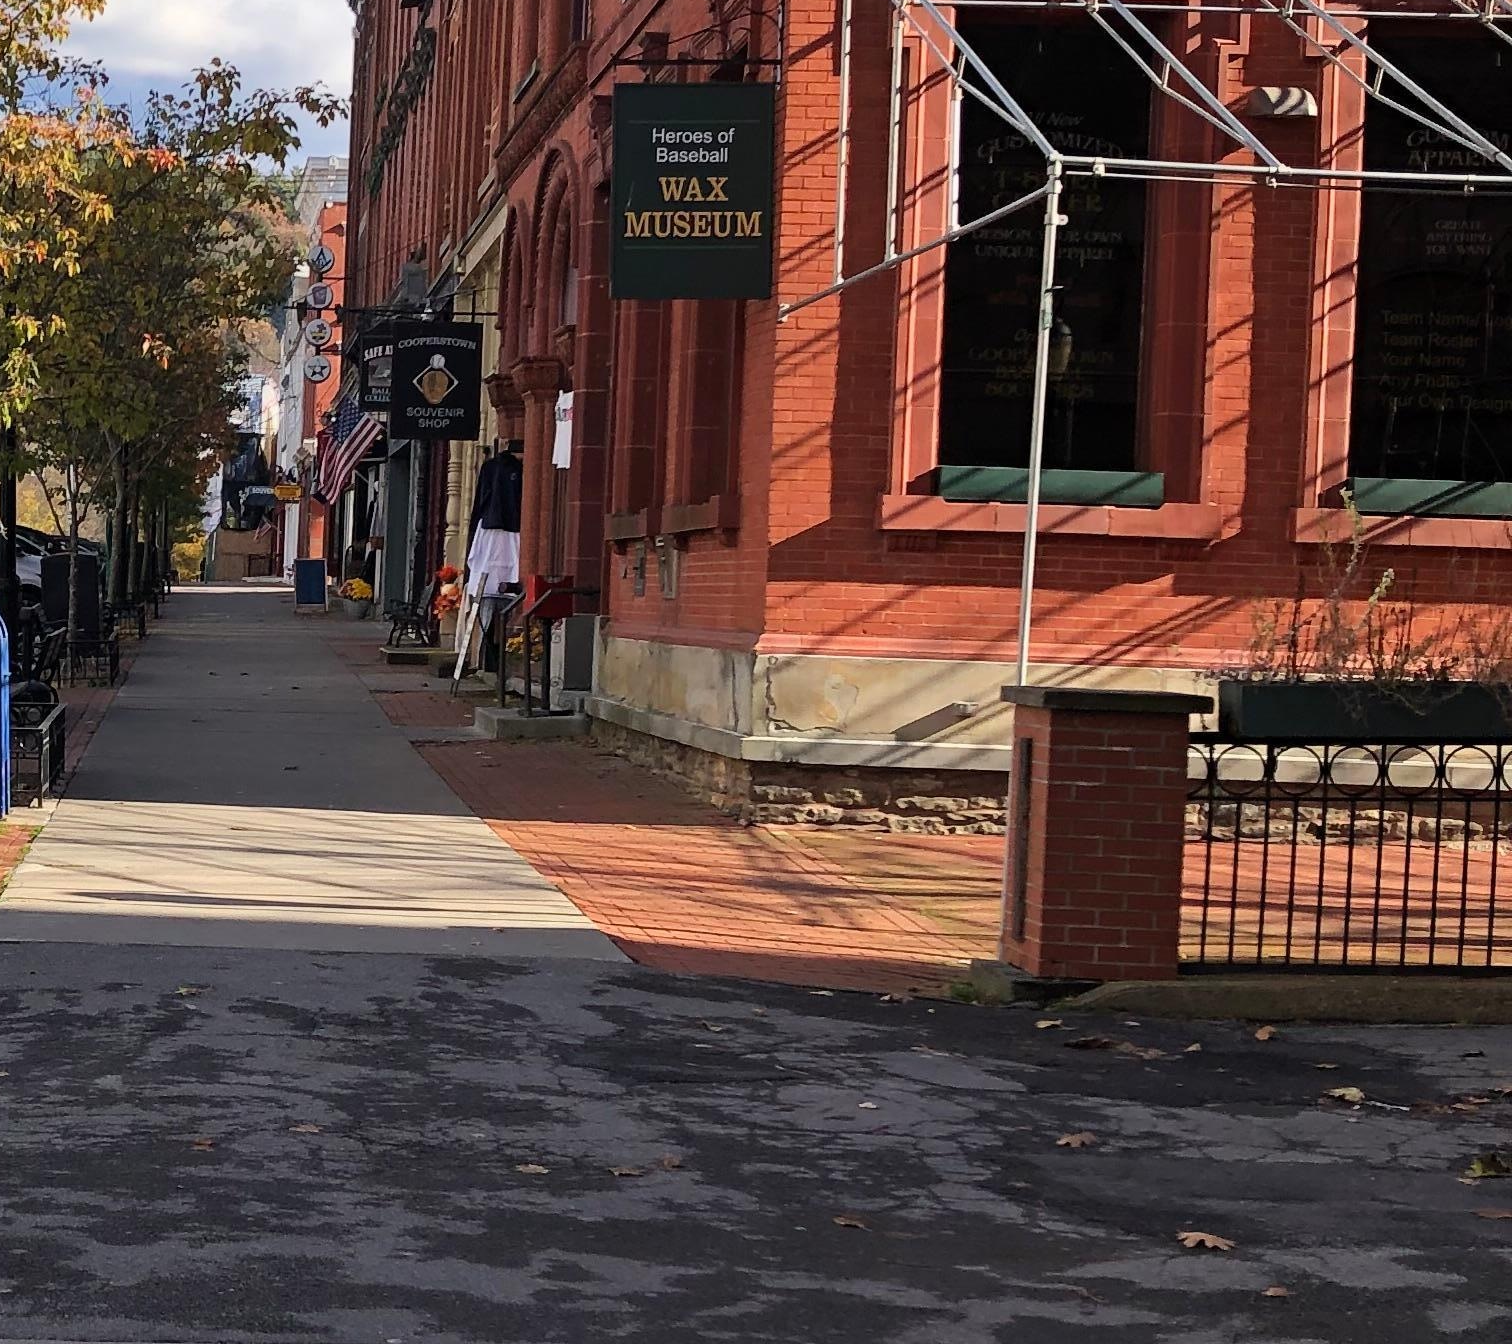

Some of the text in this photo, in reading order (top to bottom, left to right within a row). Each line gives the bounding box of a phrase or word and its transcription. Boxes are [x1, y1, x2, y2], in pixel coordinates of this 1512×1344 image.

[652, 127, 736, 144] Heroes of
[976, 130, 1124, 161] CUSOMIZED
[656, 147, 729, 163] Baseball
[1407, 149, 1502, 166] APPAR
[658, 176, 729, 202] WAX
[623, 211, 763, 238] MUSEUM
[398, 336, 477, 351] COOPERSTOWN
[363, 346, 383, 362] SAFE
[406, 407, 465, 418] SOUVENIR
[418, 418, 450, 429] SHOP
